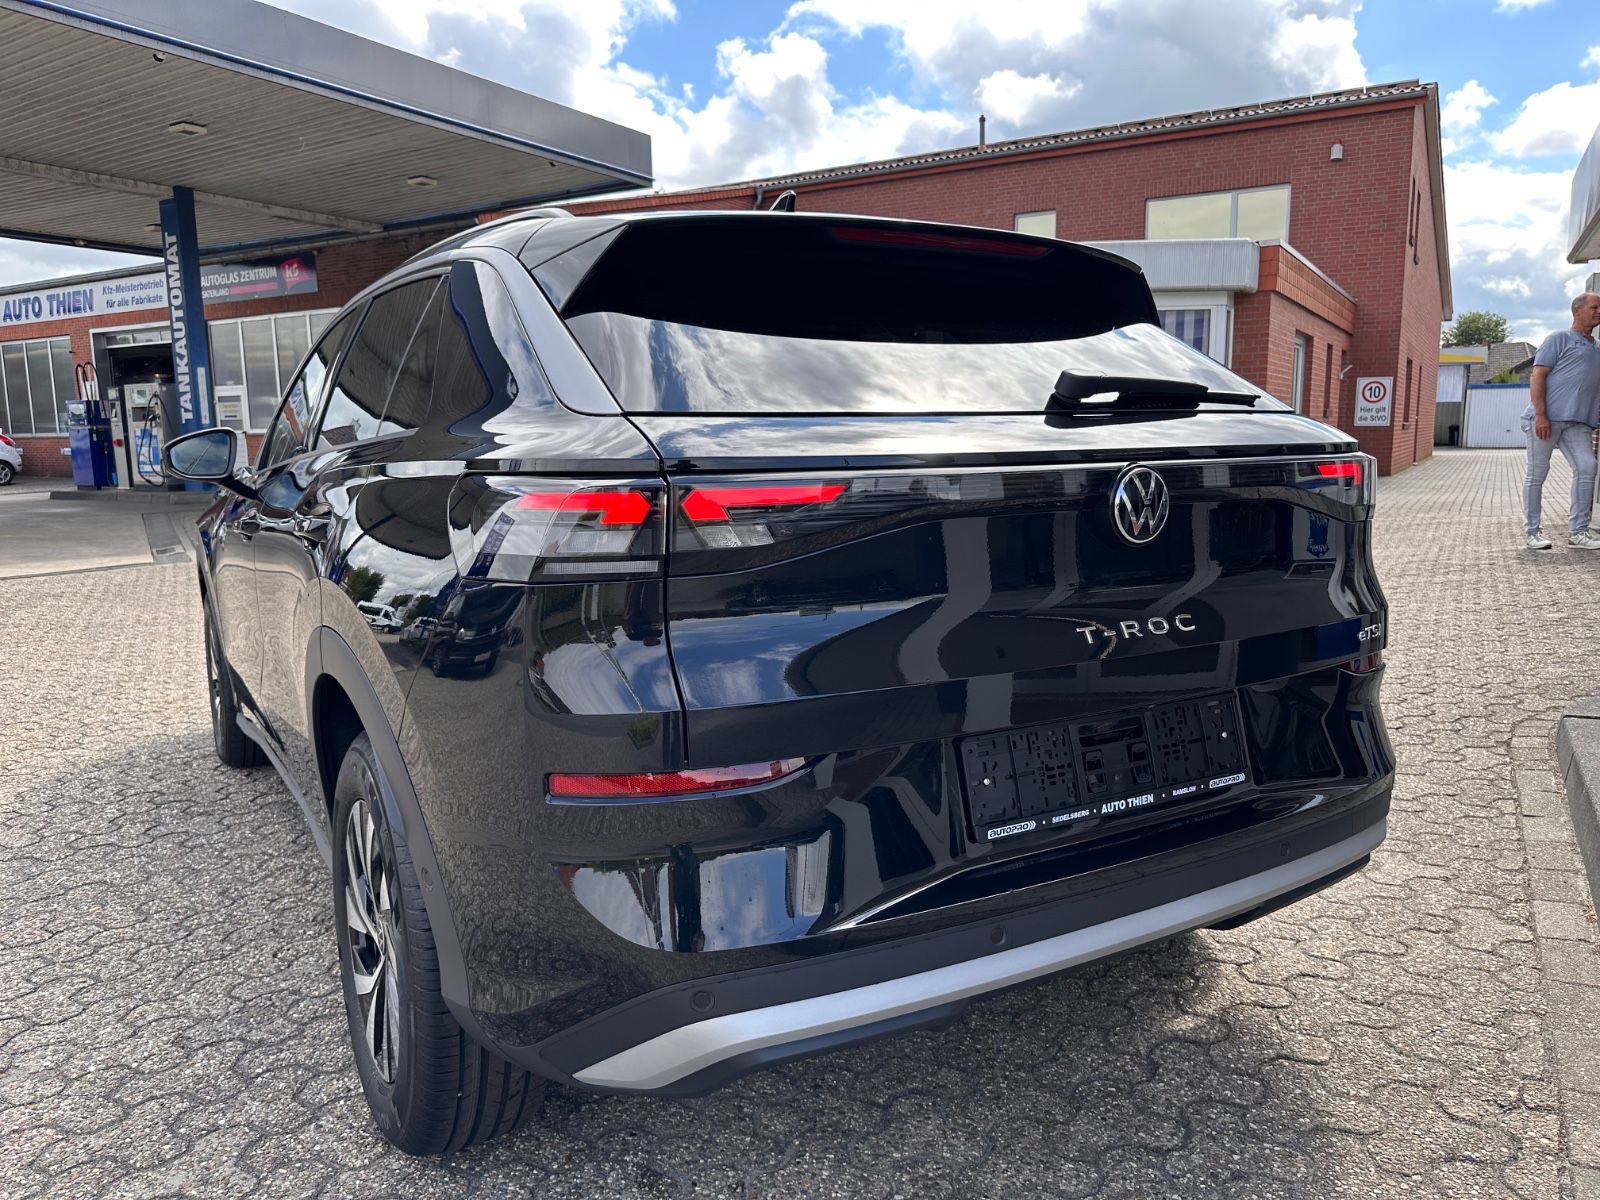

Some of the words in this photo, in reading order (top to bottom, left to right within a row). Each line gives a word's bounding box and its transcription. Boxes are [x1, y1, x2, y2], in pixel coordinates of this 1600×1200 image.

[102, 279, 164, 295] Kfz-Meisterbetrieb
[201, 271, 239, 287] AUTOGLAS
[240, 266, 277, 282] ZENTRUM
[2, 296, 43, 323] AUTO
[46, 288, 94, 317] THIEN
[106, 299, 116, 309] für
[117, 297, 129, 308] alle
[131, 294, 163, 307] Fabrikate
[165, 232, 194, 424] TANKAUTOMAT
[1367, 385, 1381, 399] 10
[1375, 406, 1386, 414] gilt
[1076, 614, 1196, 645] T-ROC
[1052, 809, 1090, 824] SEDELSBERG
[1101, 800, 1126, 814] AUTO
[1127, 793, 1154, 808] THIEN
